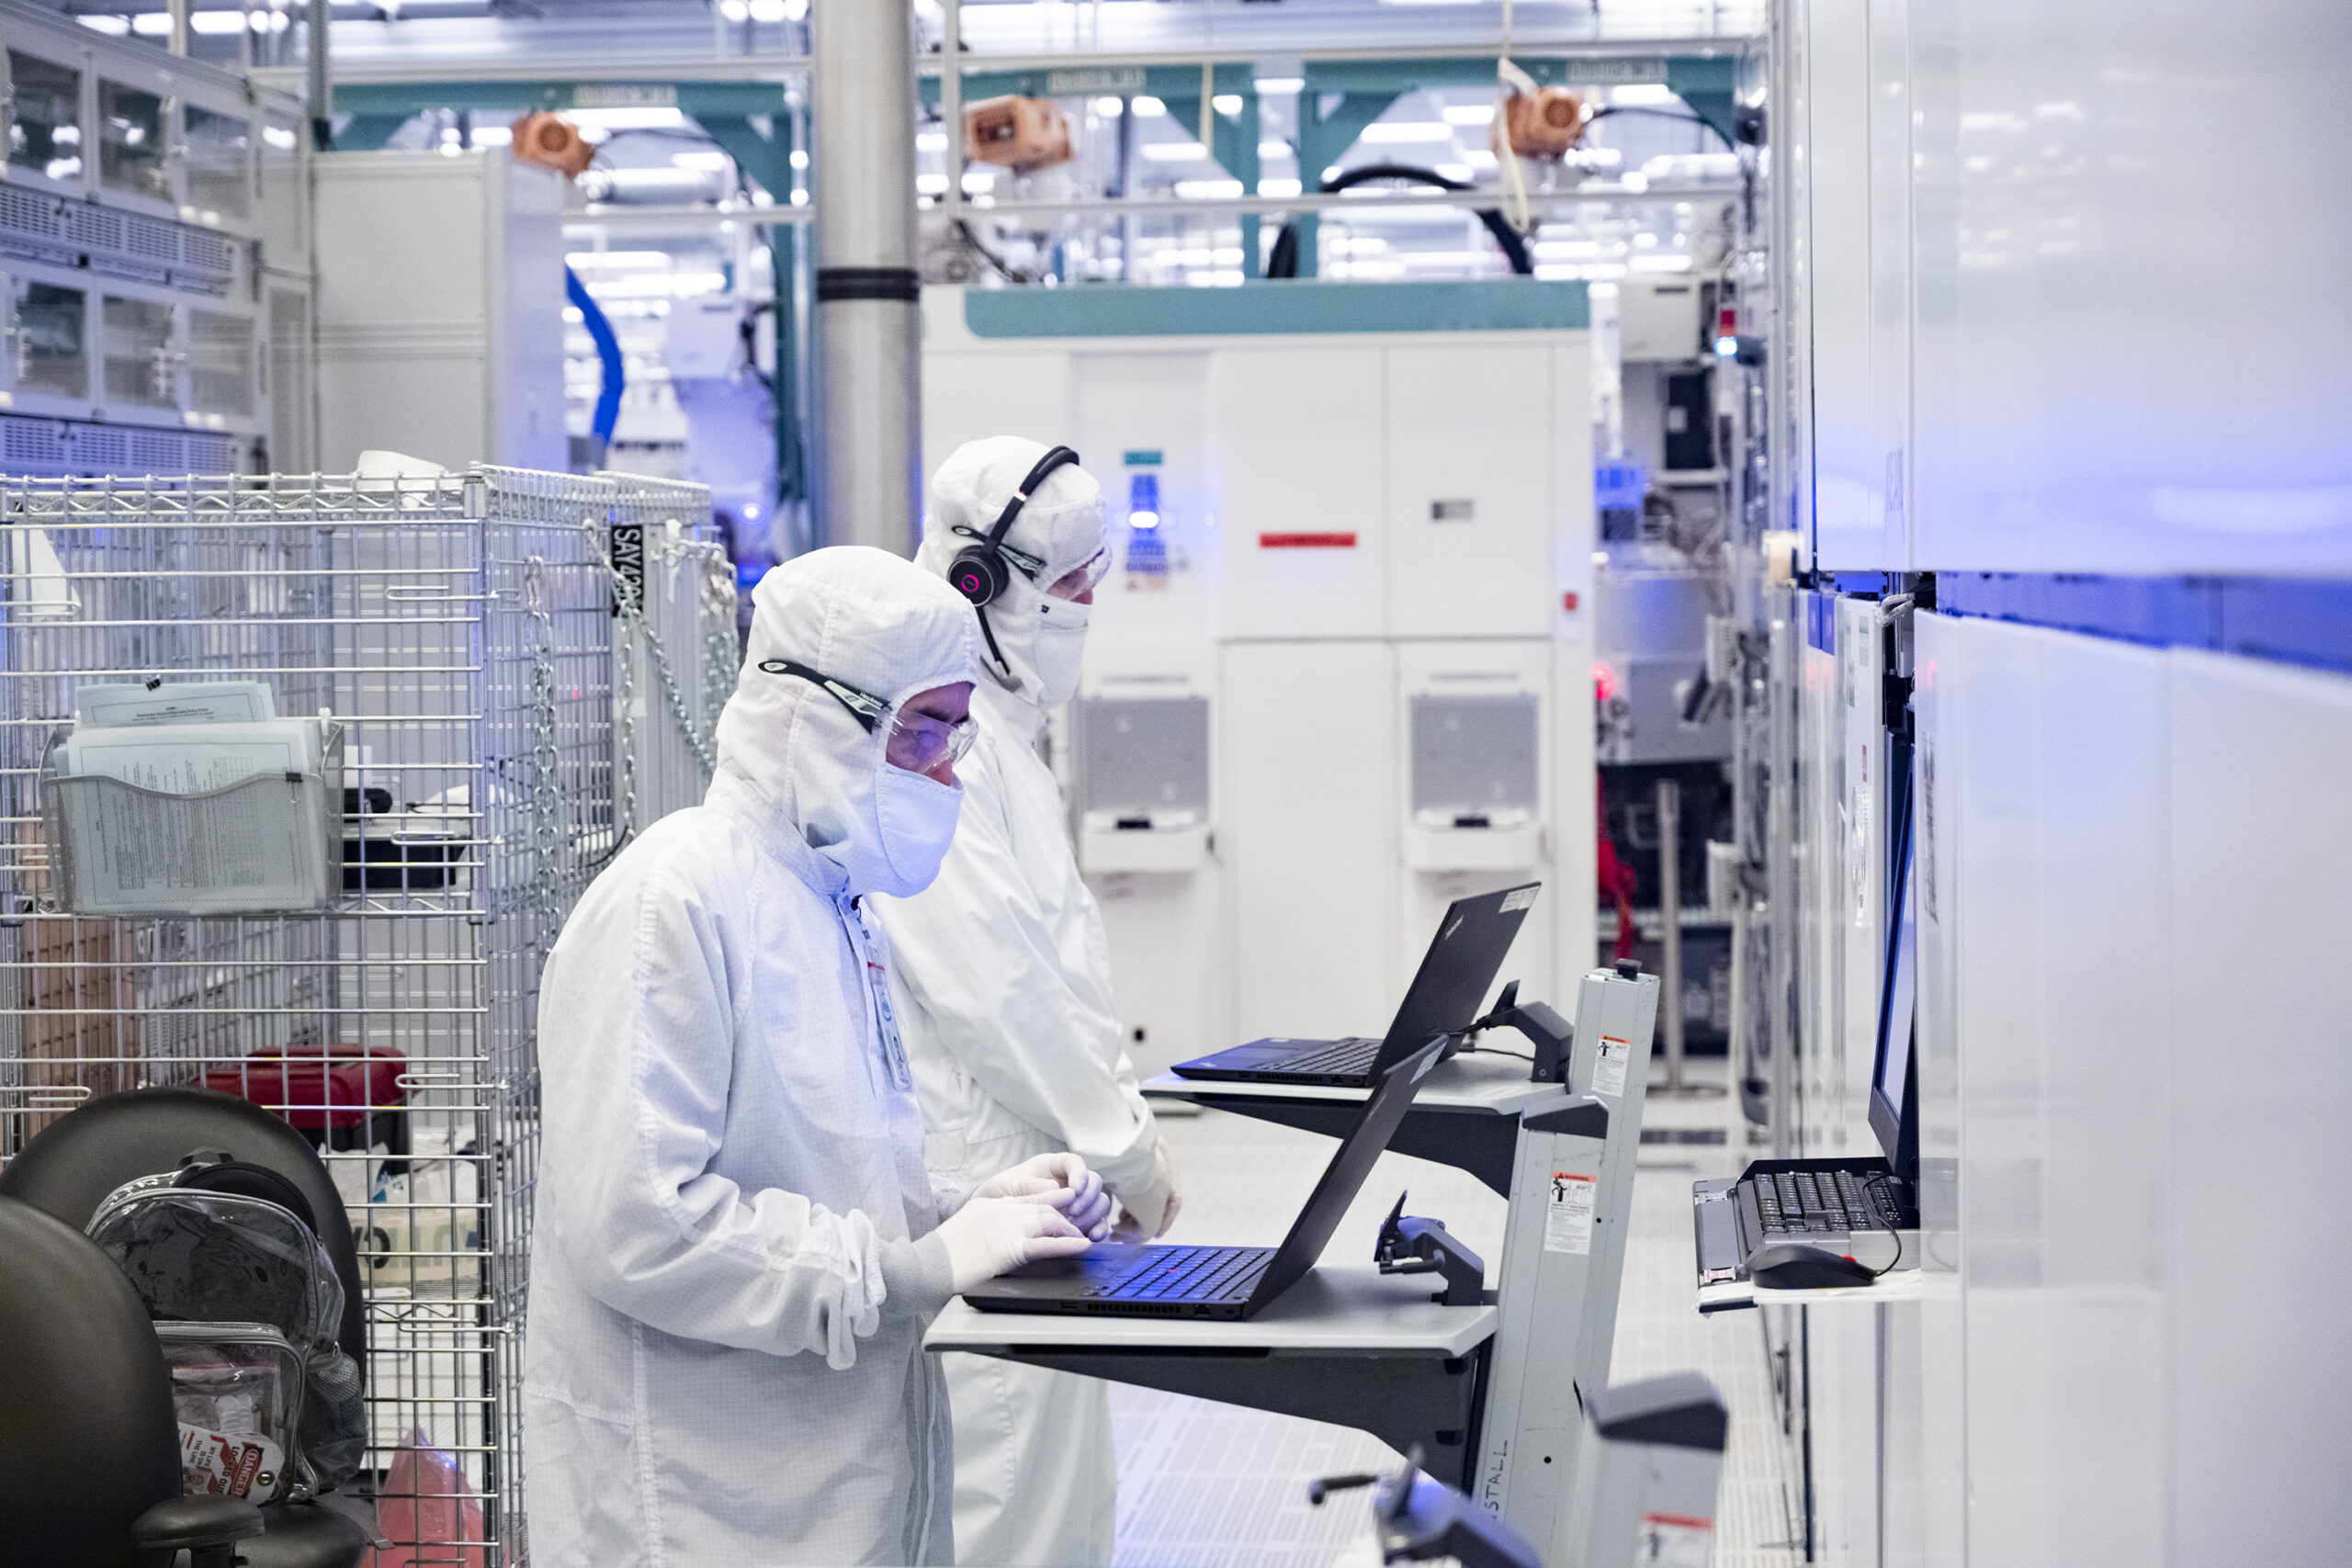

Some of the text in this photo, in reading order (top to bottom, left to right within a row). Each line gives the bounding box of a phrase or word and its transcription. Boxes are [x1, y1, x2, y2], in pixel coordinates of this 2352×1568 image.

[193, 1439, 202, 1451] THE
[216, 1446, 241, 1494] LOCKED OUT
[234, 1451, 257, 1496] DANGER
